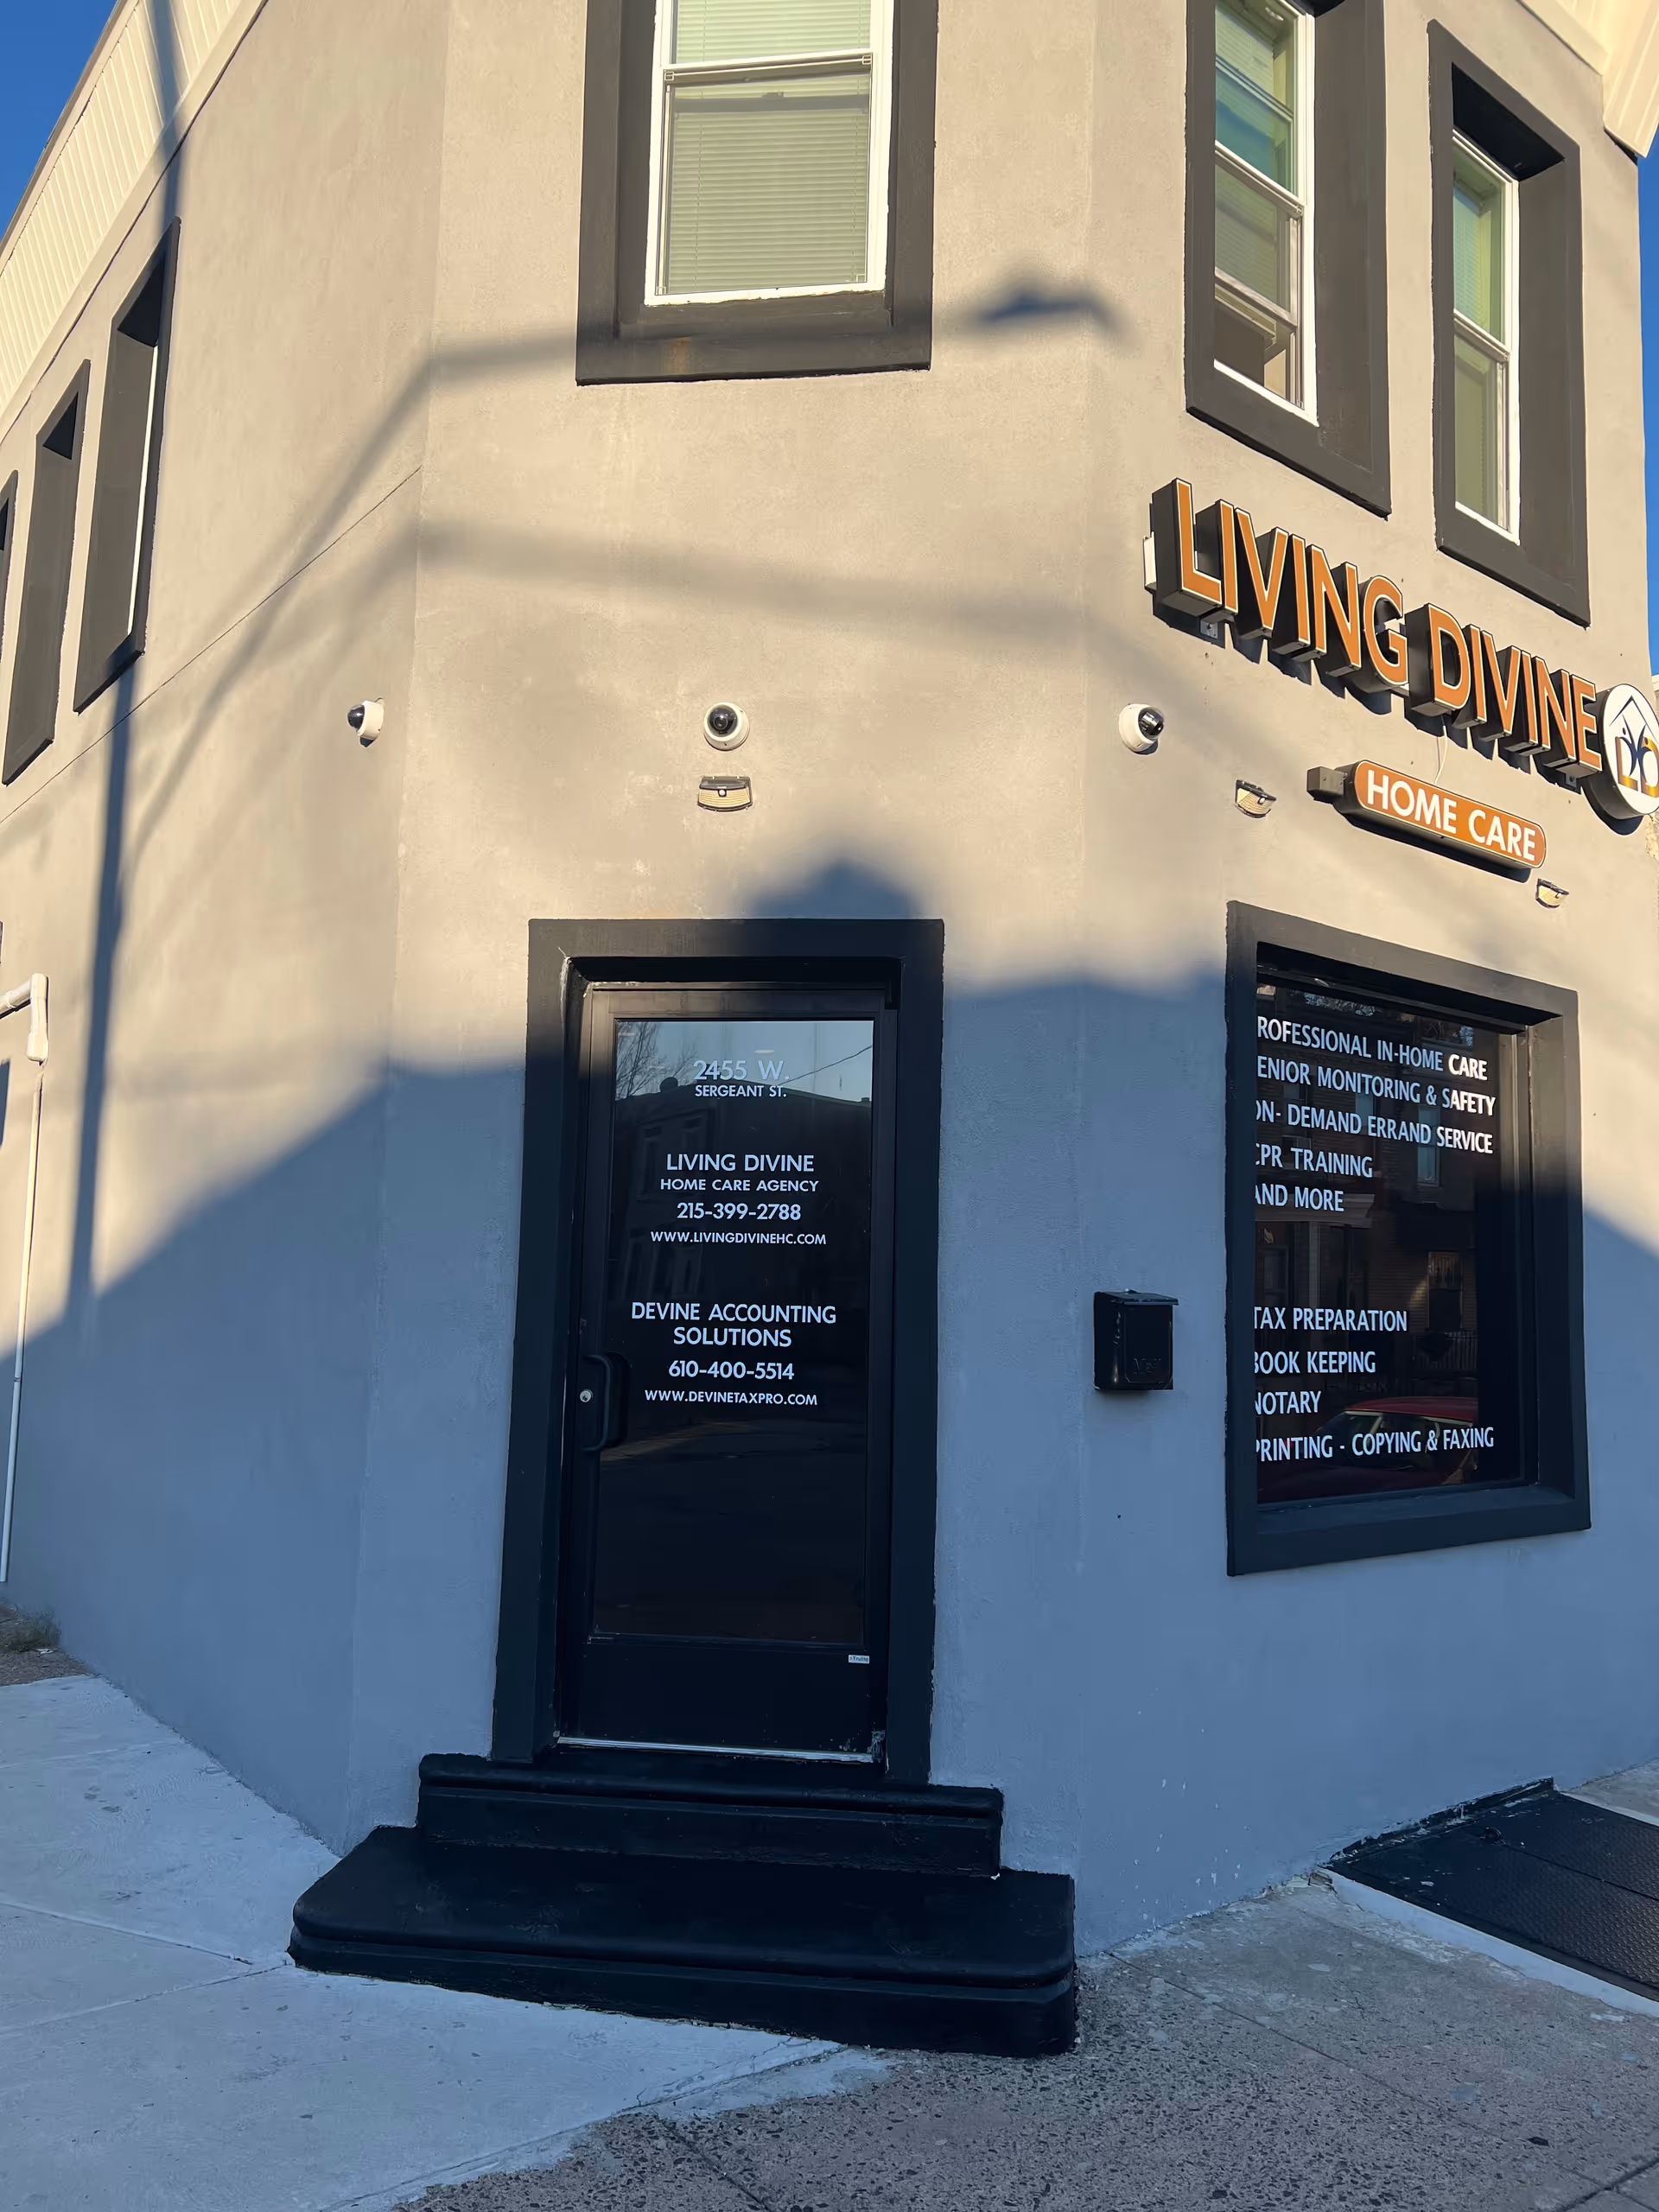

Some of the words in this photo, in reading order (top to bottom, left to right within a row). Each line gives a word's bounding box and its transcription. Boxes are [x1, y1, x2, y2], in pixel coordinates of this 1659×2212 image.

[1173, 478, 1409, 686] LIVING
[1421, 603, 1603, 774] DIVINE
[1367, 769, 1457, 835] HOME
[1468, 809, 1536, 861] CARE
[1257, 1015, 1372, 1058] ROFESSIONAL
[1377, 1039, 1444, 1071] IN-HOME
[1448, 1053, 1488, 1081] CARE
[694, 1060, 747, 1080] 2455
[758, 1060, 791, 1080] W.
[695, 1084, 765, 1097] SERGEANT
[768, 1084, 787, 1098] ST.
[1257, 1055, 1312, 1085] ENIOR
[1318, 1065, 1421, 1103] MONITORING
[1425, 1084, 1437, 1106] &
[1442, 1088, 1497, 1116] SAFETY
[1287, 1103, 1362, 1135] DEMAND
[1367, 1115, 1432, 1144] ERRAND
[1436, 1126, 1493, 1154] SERVICE
[666, 1154, 736, 1172] LIVING
[744, 1154, 815, 1173] DIVINE
[1290, 1147, 1373, 1178] TRAINING
[660, 1179, 707, 1191] HOME
[711, 1179, 751, 1192] CARE
[755, 1179, 819, 1192] AGENCY
[1294, 1185, 1344, 1212] MORE
[677, 1202, 801, 1221] 215-399-2788
[650, 1230, 827, 1245] WWW.LIVINGDIVINEHC.COM
[632, 1301, 701, 1320] DEVINE
[708, 1303, 836, 1324] ACCOUNTING
[1293, 1307, 1408, 1332] PREPARATION
[673, 1326, 792, 1348] SOLUTIONS
[668, 1360, 795, 1380] 610-400-5514
[1306, 1351, 1376, 1374] KEEPING
[645, 1389, 817, 1406] WWW.DEVINETAXPRO.COM
[1351, 1430, 1421, 1456] COPYING
[1427, 1429, 1438, 1452] &
[1443, 1427, 1494, 1450] FAXING
